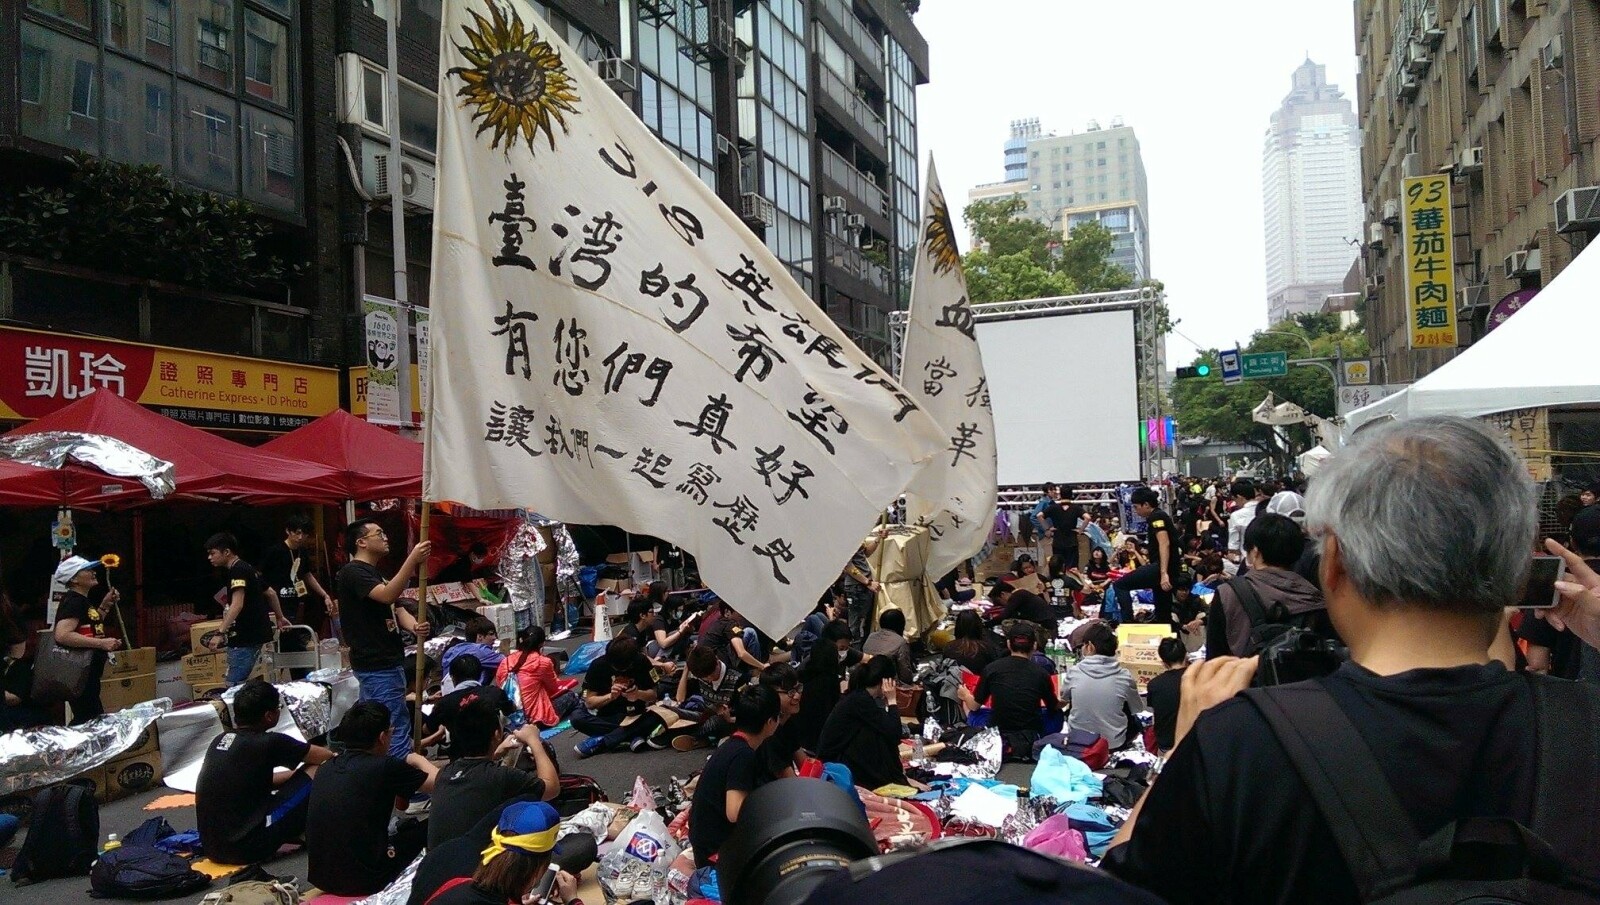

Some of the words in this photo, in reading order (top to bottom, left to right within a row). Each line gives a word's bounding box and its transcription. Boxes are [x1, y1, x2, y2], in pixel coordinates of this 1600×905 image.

[1407, 180, 1445, 205] 93
[25, 346, 127, 399] 凱玲
[159, 361, 308, 395] 證照專門店
[160, 385, 216, 401] Catherine
[218, 391, 258, 405] Express
[267, 395, 277, 406] ID
[280, 396, 308, 409] Photo
[487, 300, 815, 505] 有您們真好
[485, 400, 796, 586] 讓我們一起寫歷史
